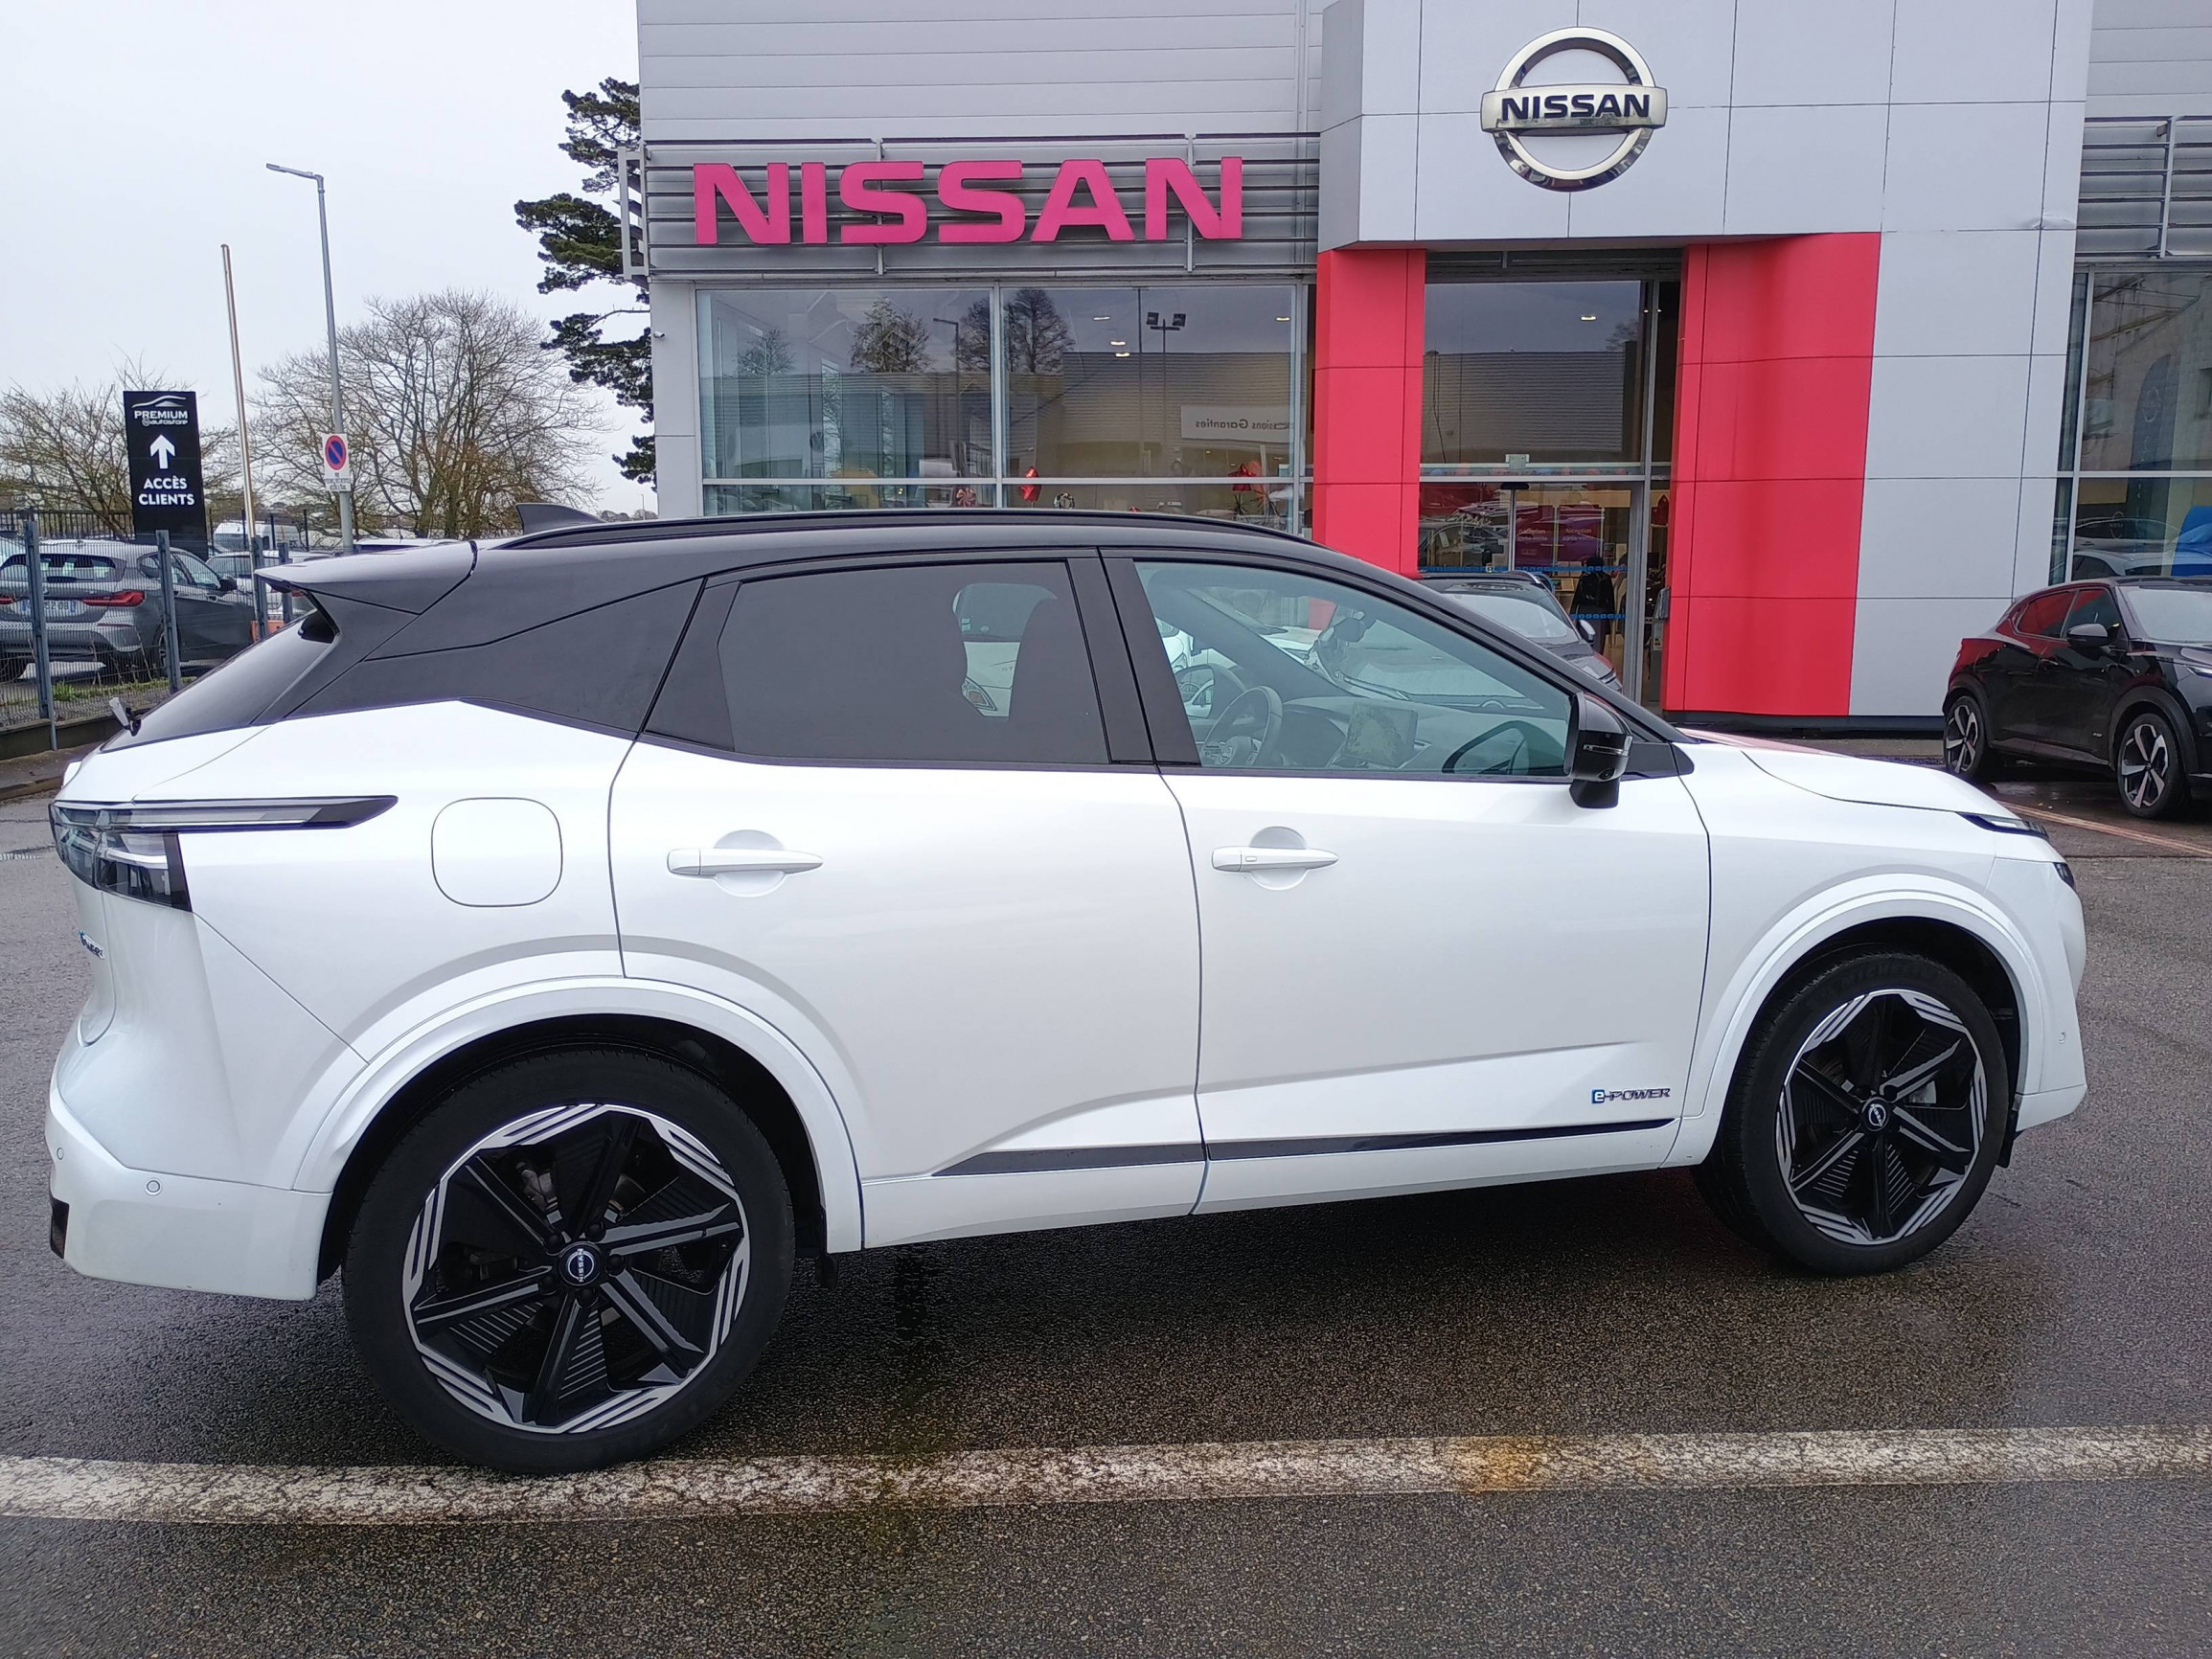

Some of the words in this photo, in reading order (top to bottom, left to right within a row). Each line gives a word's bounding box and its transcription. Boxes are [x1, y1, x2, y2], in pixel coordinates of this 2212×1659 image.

[1501, 94, 1651, 122] NISSAN
[693, 157, 1243, 244] NISSAN
[134, 410, 189, 420] PREMIUM
[143, 475, 188, 489] ACCÈS
[138, 493, 195, 506] CLIENTS
[1591, 1088, 1671, 1104] e-POWER
